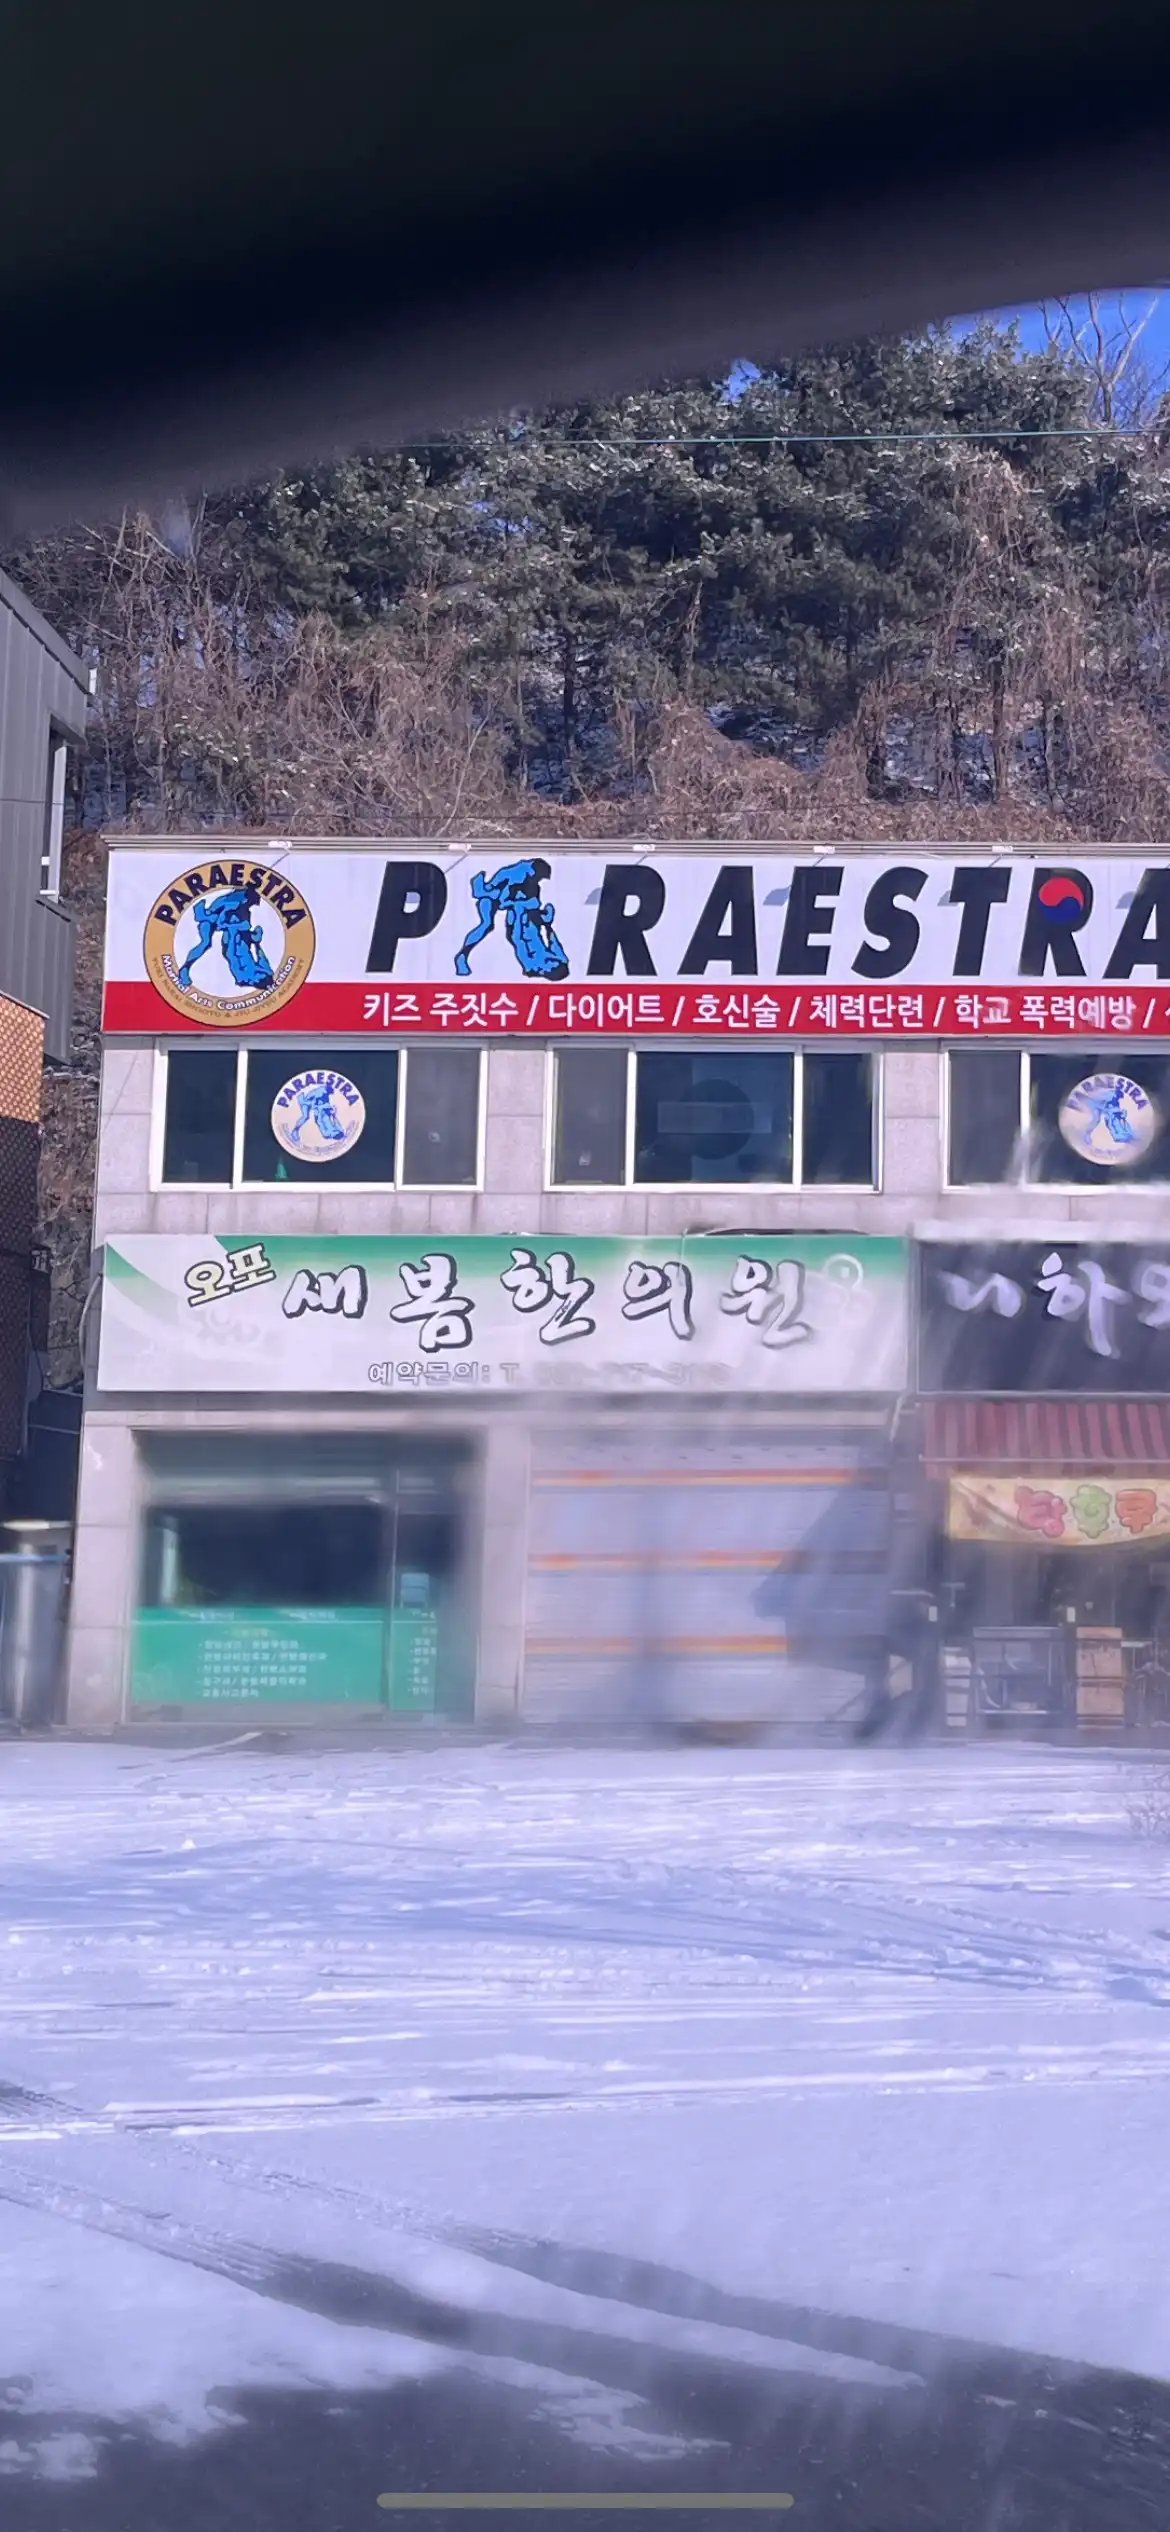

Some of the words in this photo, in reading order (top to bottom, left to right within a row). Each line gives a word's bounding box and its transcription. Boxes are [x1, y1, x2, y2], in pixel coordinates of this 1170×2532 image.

[154, 864, 307, 929] PARAESTRA
[162, 954, 190, 994] Martial
[189, 992, 213, 1008] Arts
[217, 956, 296, 1009] Communication
[363, 992, 422, 1027] 키즈
[429, 992, 519, 1027] 주짓수
[526, 994, 540, 1026] /
[549, 992, 665, 1028] 다이어트
[671, 996, 686, 1027] /
[692, 993, 781, 1028] 호신술
[788, 996, 802, 1027] /
[809, 993, 923, 1029] 체력단련
[932, 996, 946, 1027] /
[954, 994, 1012, 1029] 학교
[1019, 995, 1137, 1030] 폭력예방
[276, 1072, 360, 1107] PARAESTRA
[184, 1243, 276, 1307] 오포
[367, 1361, 490, 1387] 예약문의:
